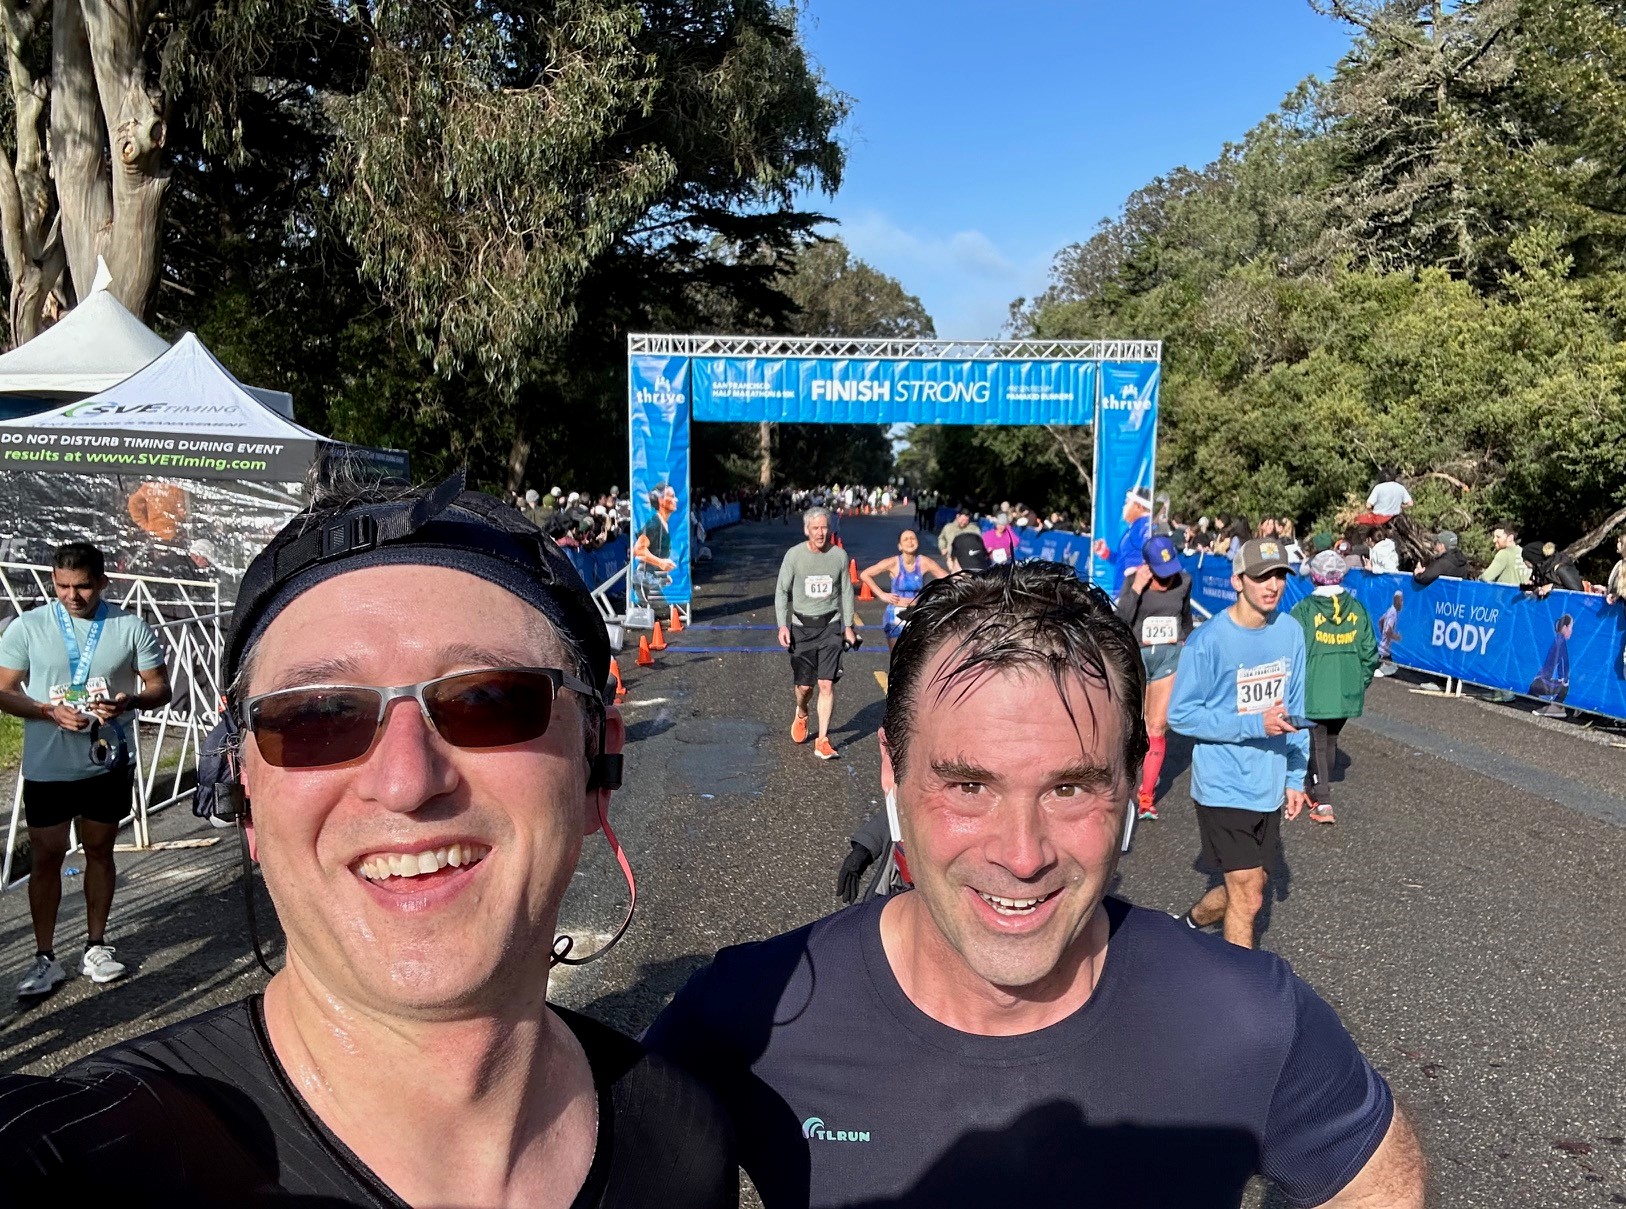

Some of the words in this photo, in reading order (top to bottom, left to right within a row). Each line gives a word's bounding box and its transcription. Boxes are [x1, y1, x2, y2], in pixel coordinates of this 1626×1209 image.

[636, 387, 686, 405] thrive
[811, 380, 891, 402] FINISH
[894, 380, 991, 403] STRONG
[1102, 393, 1152, 410] thrive
[1, 433, 23, 444] DO
[26, 434, 59, 446] NOT
[60, 435, 120, 447] DISTURB
[123, 437, 175, 450] TIMING
[178, 440, 234, 453] DURING
[237, 442, 284, 455] EVENT
[4, 449, 60, 462] results
[64, 451, 82, 462] at
[86, 453, 267, 471] www.SVETiming.com
[810, 583, 828, 593] 612
[1435, 601, 1466, 619] MOVE
[1470, 605, 1499, 623] YOUR
[1146, 626, 1174, 638] 3253
[1315, 629, 1336, 645] CROSS
[1431, 618, 1496, 655] BODY
[78, 622, 100, 668] FRANCISCO
[73, 669, 84, 685] SAN
[1241, 678, 1282, 703] 3047
